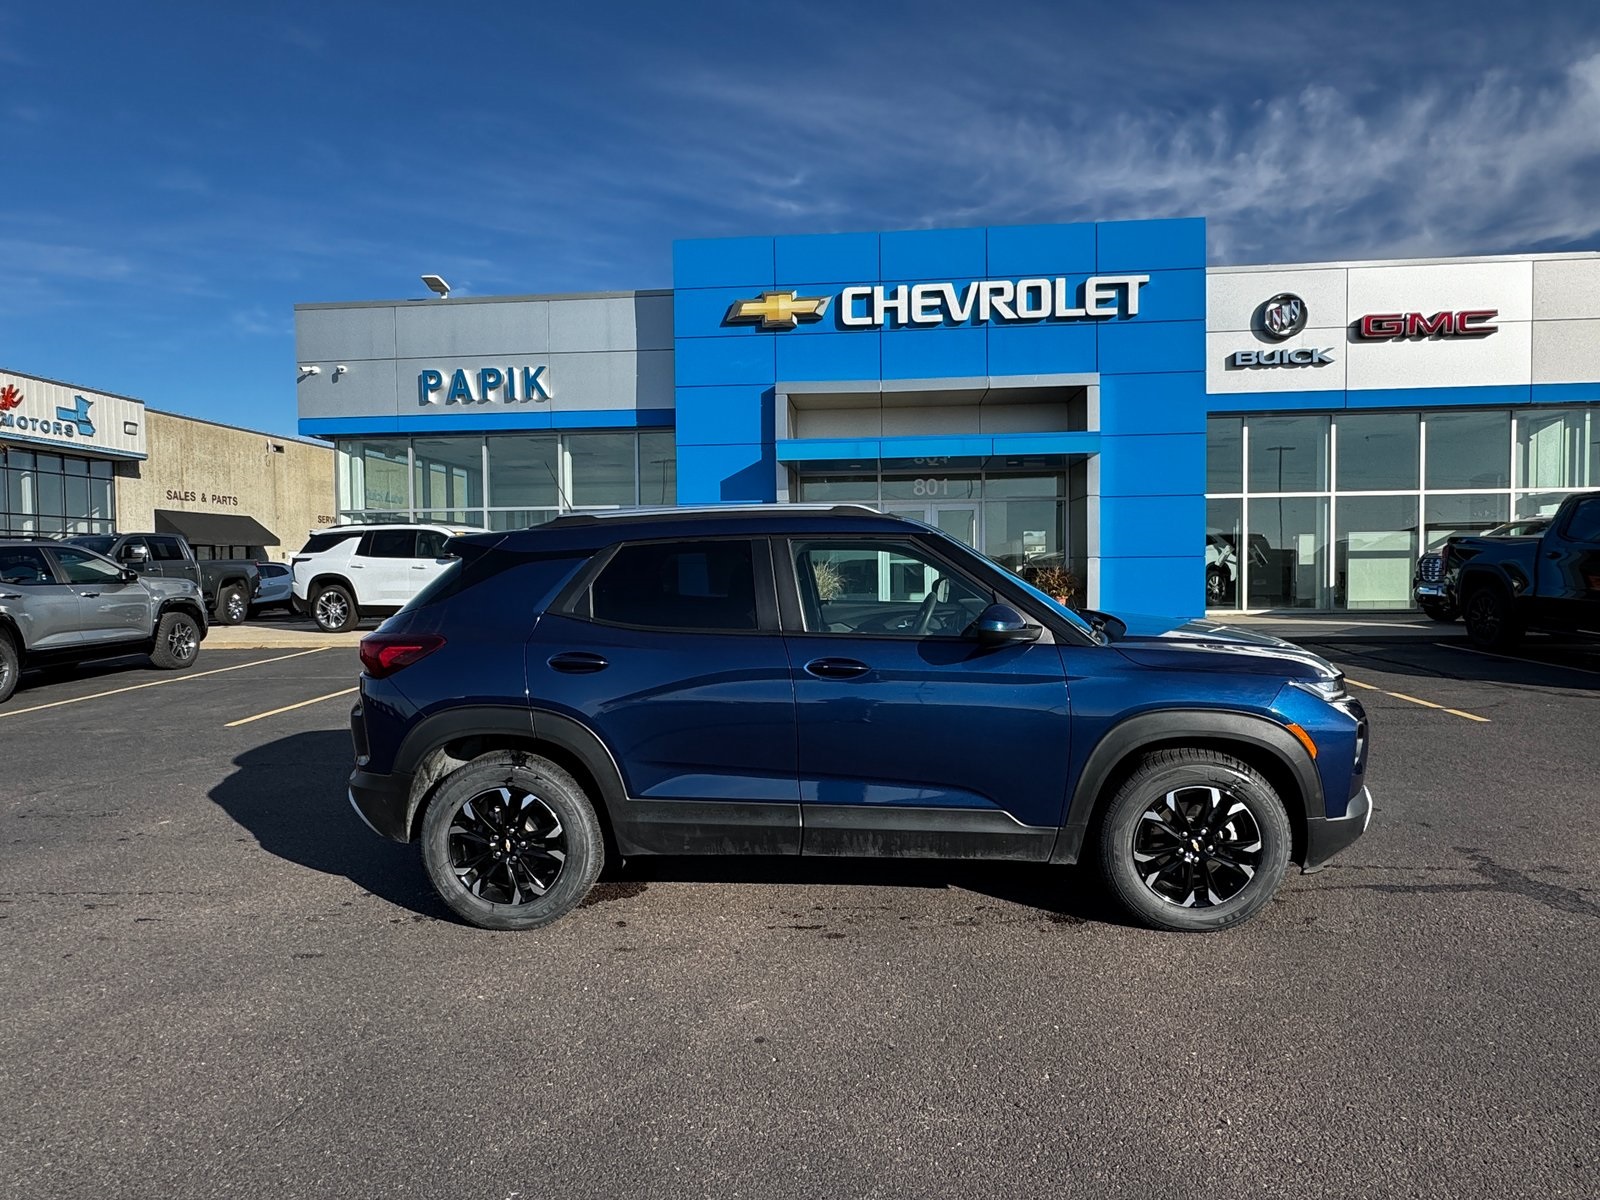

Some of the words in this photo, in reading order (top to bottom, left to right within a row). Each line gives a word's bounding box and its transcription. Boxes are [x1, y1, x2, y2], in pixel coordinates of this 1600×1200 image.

[842, 275, 1150, 326] CHEVROLET
[1361, 309, 1498, 338] GMC
[1235, 347, 1335, 366] BUICK
[421, 366, 551, 402] PAPIK
[913, 478, 948, 496] 801
[166, 489, 196, 502] SALES
[201, 492, 207, 502] &
[211, 494, 238, 506] PARTS
[317, 515, 337, 524] SERV
